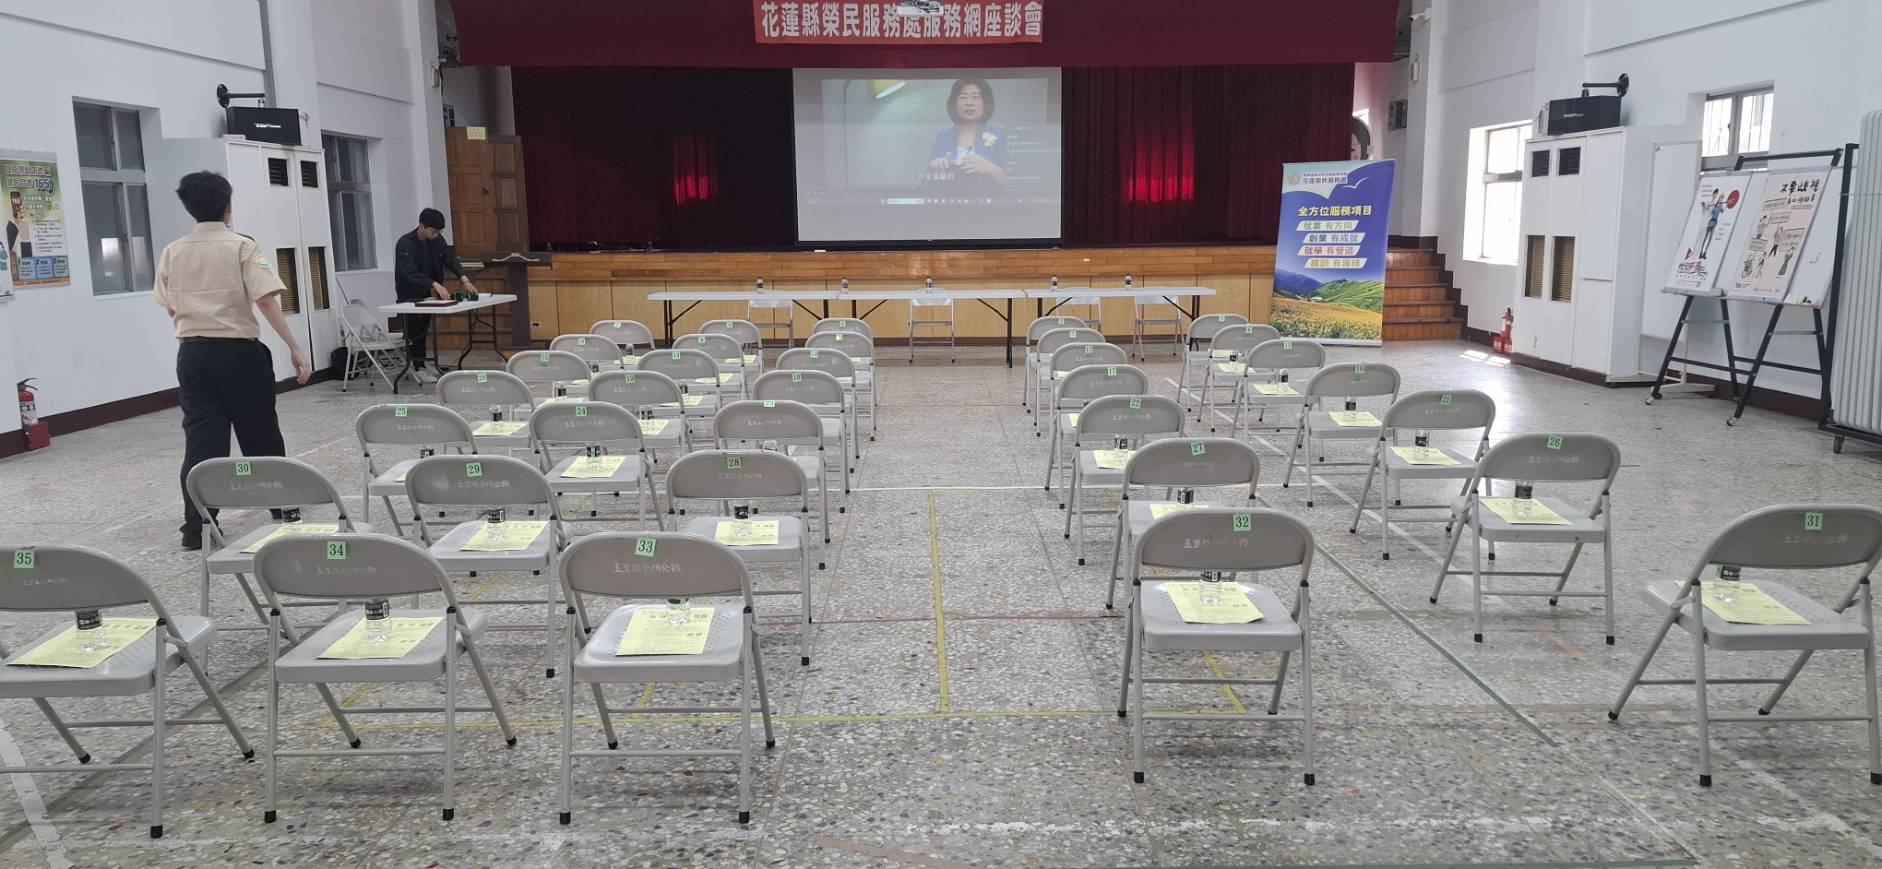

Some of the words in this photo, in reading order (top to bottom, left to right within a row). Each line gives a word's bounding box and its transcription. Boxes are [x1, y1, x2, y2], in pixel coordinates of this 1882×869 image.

[761, 1, 1042, 38] 花蓮縣榮民服務處服務網座談會
[1298, 205, 1372, 217] 全方位服務項目
[396, 407, 406, 416] 25
[577, 407, 587, 416] 24
[1192, 442, 1204, 454] 27
[1549, 437, 1561, 447] 26
[237, 462, 249, 473] 30
[728, 457, 741, 467] 28
[468, 464, 480, 475] 29
[1235, 515, 1249, 528] 32
[1806, 514, 1820, 527] 31
[329, 543, 345, 557] 34
[637, 539, 654, 553] 33
[15, 551, 33, 566] 35
